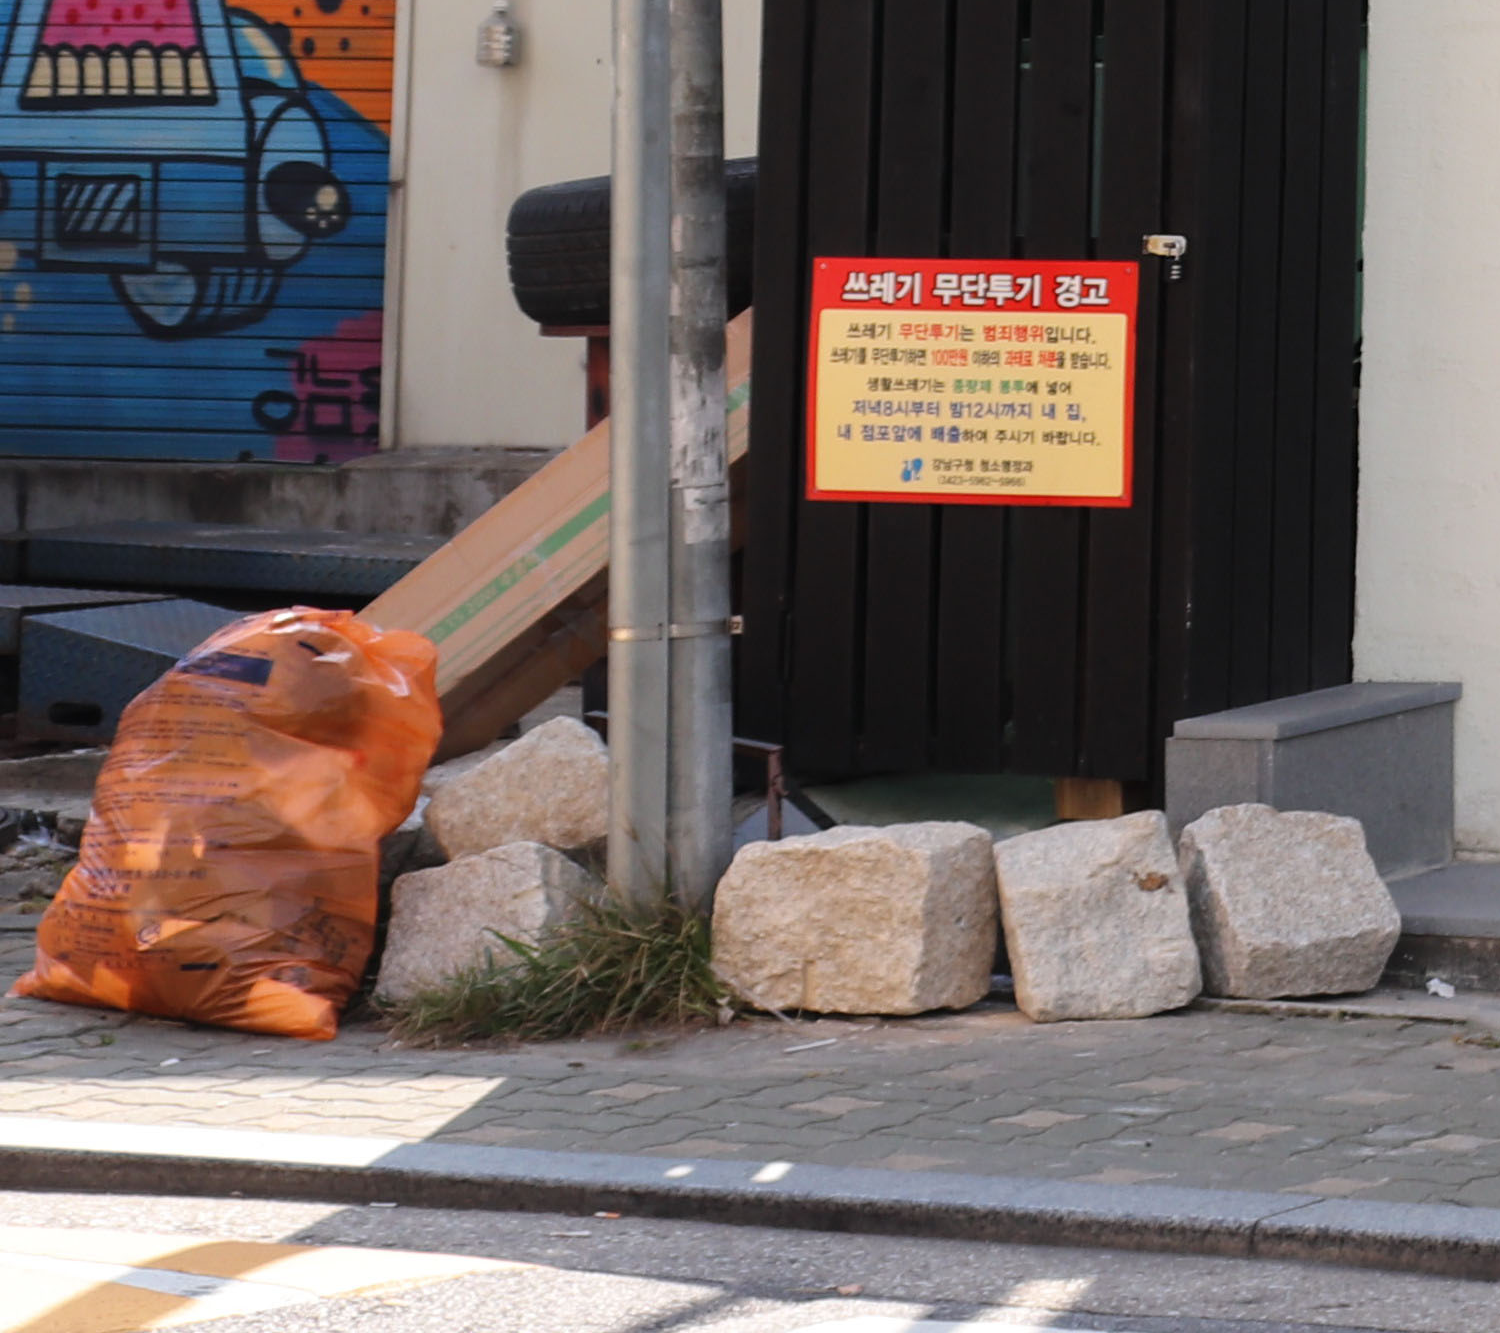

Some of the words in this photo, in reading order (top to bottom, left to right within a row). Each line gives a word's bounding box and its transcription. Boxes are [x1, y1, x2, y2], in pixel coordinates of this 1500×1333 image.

[842, 271, 923, 304] 쓰레기
[932, 273, 1042, 307] 무단투기
[1054, 275, 1111, 309] 경고
[846, 323, 892, 341] 쓰레기
[898, 323, 976, 342] 무단투기는
[982, 324, 1098, 345] 범죄행위입니다.
[830, 347, 867, 365] 쓰레기를
[871, 348, 927, 367] 무단투기하면
[931, 349, 969, 367] 100만원
[866, 376, 946, 394] 생활쓰레기는
[852, 399, 942, 418] 저녁8시부터
[948, 401, 1033, 420] 밤12시까지
[1041, 402, 1057, 420] 내
[836, 424, 852, 442] 내
[860, 425, 923, 443] 점포앞에
[930, 425, 989, 444] 배출하여
[994, 429, 1036, 445] 주시기
[1041, 429, 1103, 447] 바랍니다.
